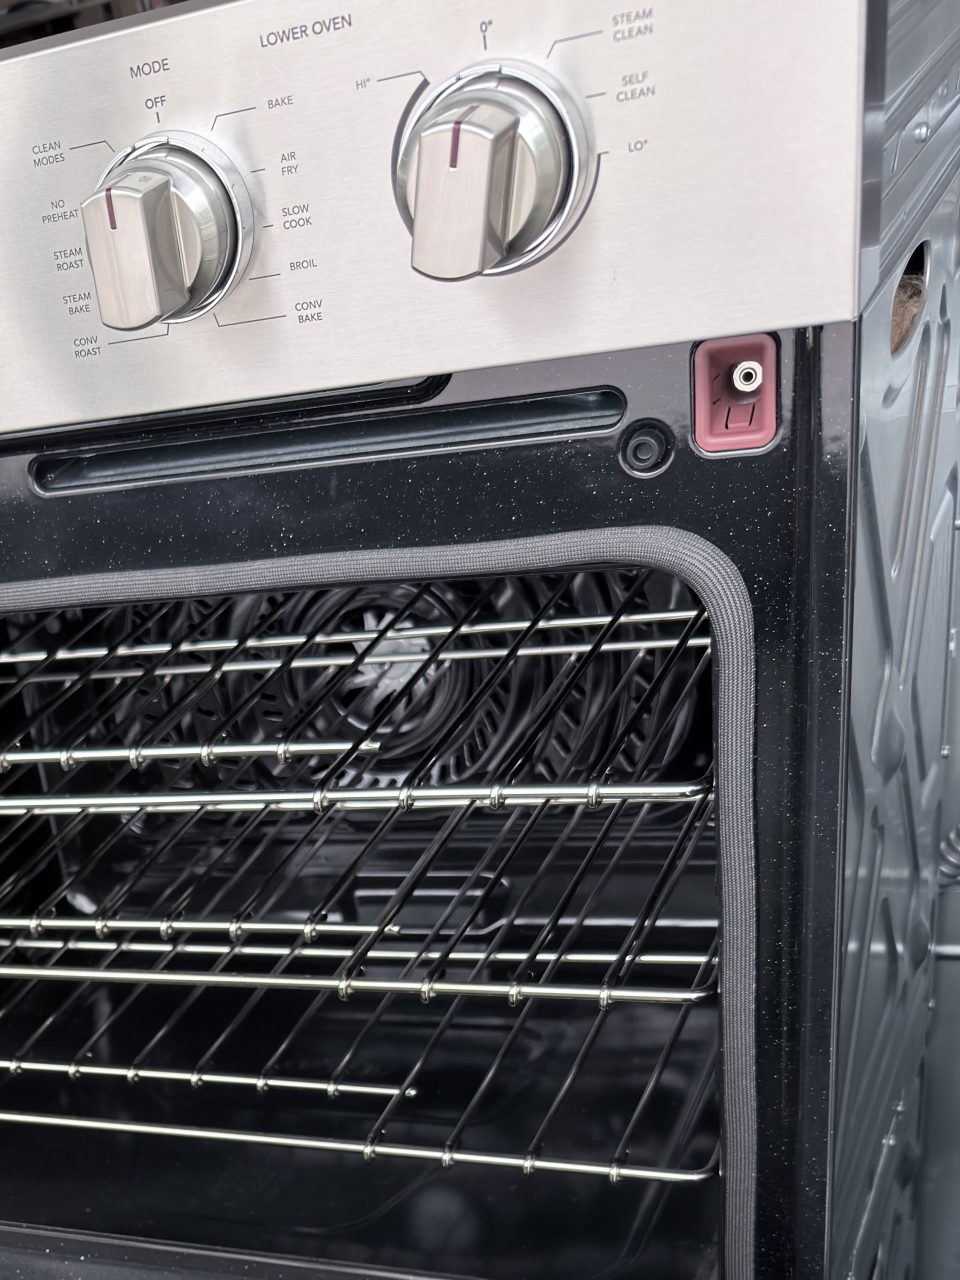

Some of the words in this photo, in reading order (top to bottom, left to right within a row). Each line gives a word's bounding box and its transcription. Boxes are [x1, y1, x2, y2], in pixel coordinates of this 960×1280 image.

[611, 8, 654, 27] STEAM
[259, 24, 309, 48] LOWER
[311, 14, 353, 36] OVEN
[612, 24, 654, 42] CLEAN
[129, 58, 171, 79] MODE
[621, 71, 649, 86] SELF
[616, 85, 656, 103] CLEAN
[144, 95, 167, 110] OFF
[267, 95, 294, 110] BAKE
[32, 140, 62, 155] CLEAN
[33, 153, 66, 168] MODES
[280, 151, 297, 163] AIR
[281, 164, 299, 177] FRY
[51, 199, 65, 211] NO
[281, 204, 310, 217] SLOW
[42, 209, 79, 224] PREHEAT
[283, 216, 312, 231] COOK
[53, 247, 83, 261] STEAM
[56, 259, 84, 272] ROAST
[289, 258, 318, 271] BROIL
[62, 292, 92, 304] STEAM
[68, 303, 91, 315] BAKE
[294, 299, 323, 312] CONV
[298, 311, 323, 324] BAKE
[73, 335, 99, 348] CONV
[74, 346, 102, 360] ROAST
